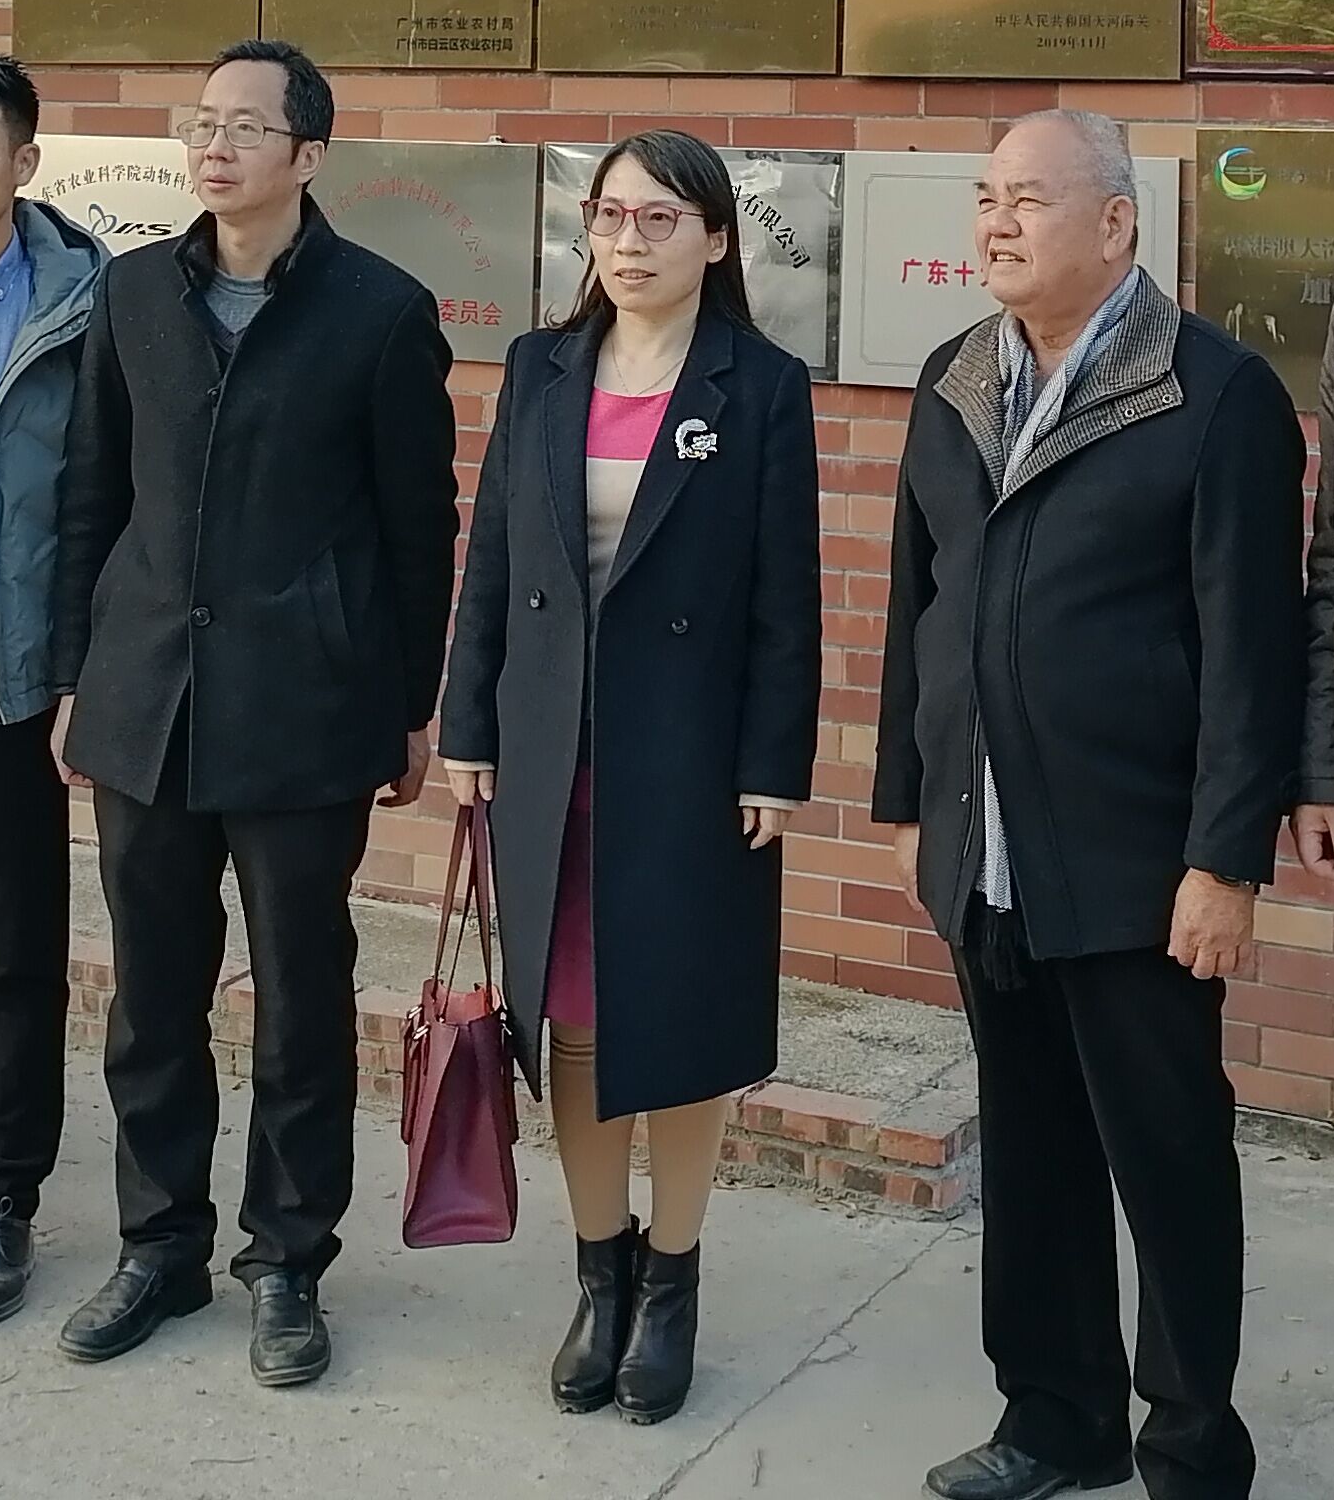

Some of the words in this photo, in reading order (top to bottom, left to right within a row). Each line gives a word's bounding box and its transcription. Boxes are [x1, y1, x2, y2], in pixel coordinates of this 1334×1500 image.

[396, 17, 514, 30] 广州市农业农村局
[396, 38, 514, 52] 广州市白云区农业农村局
[1036, 36, 1107, 50] 2019年11月
[32, 164, 197, 203] 东省农业科学院动物科
[438, 298, 504, 327] 委员会
